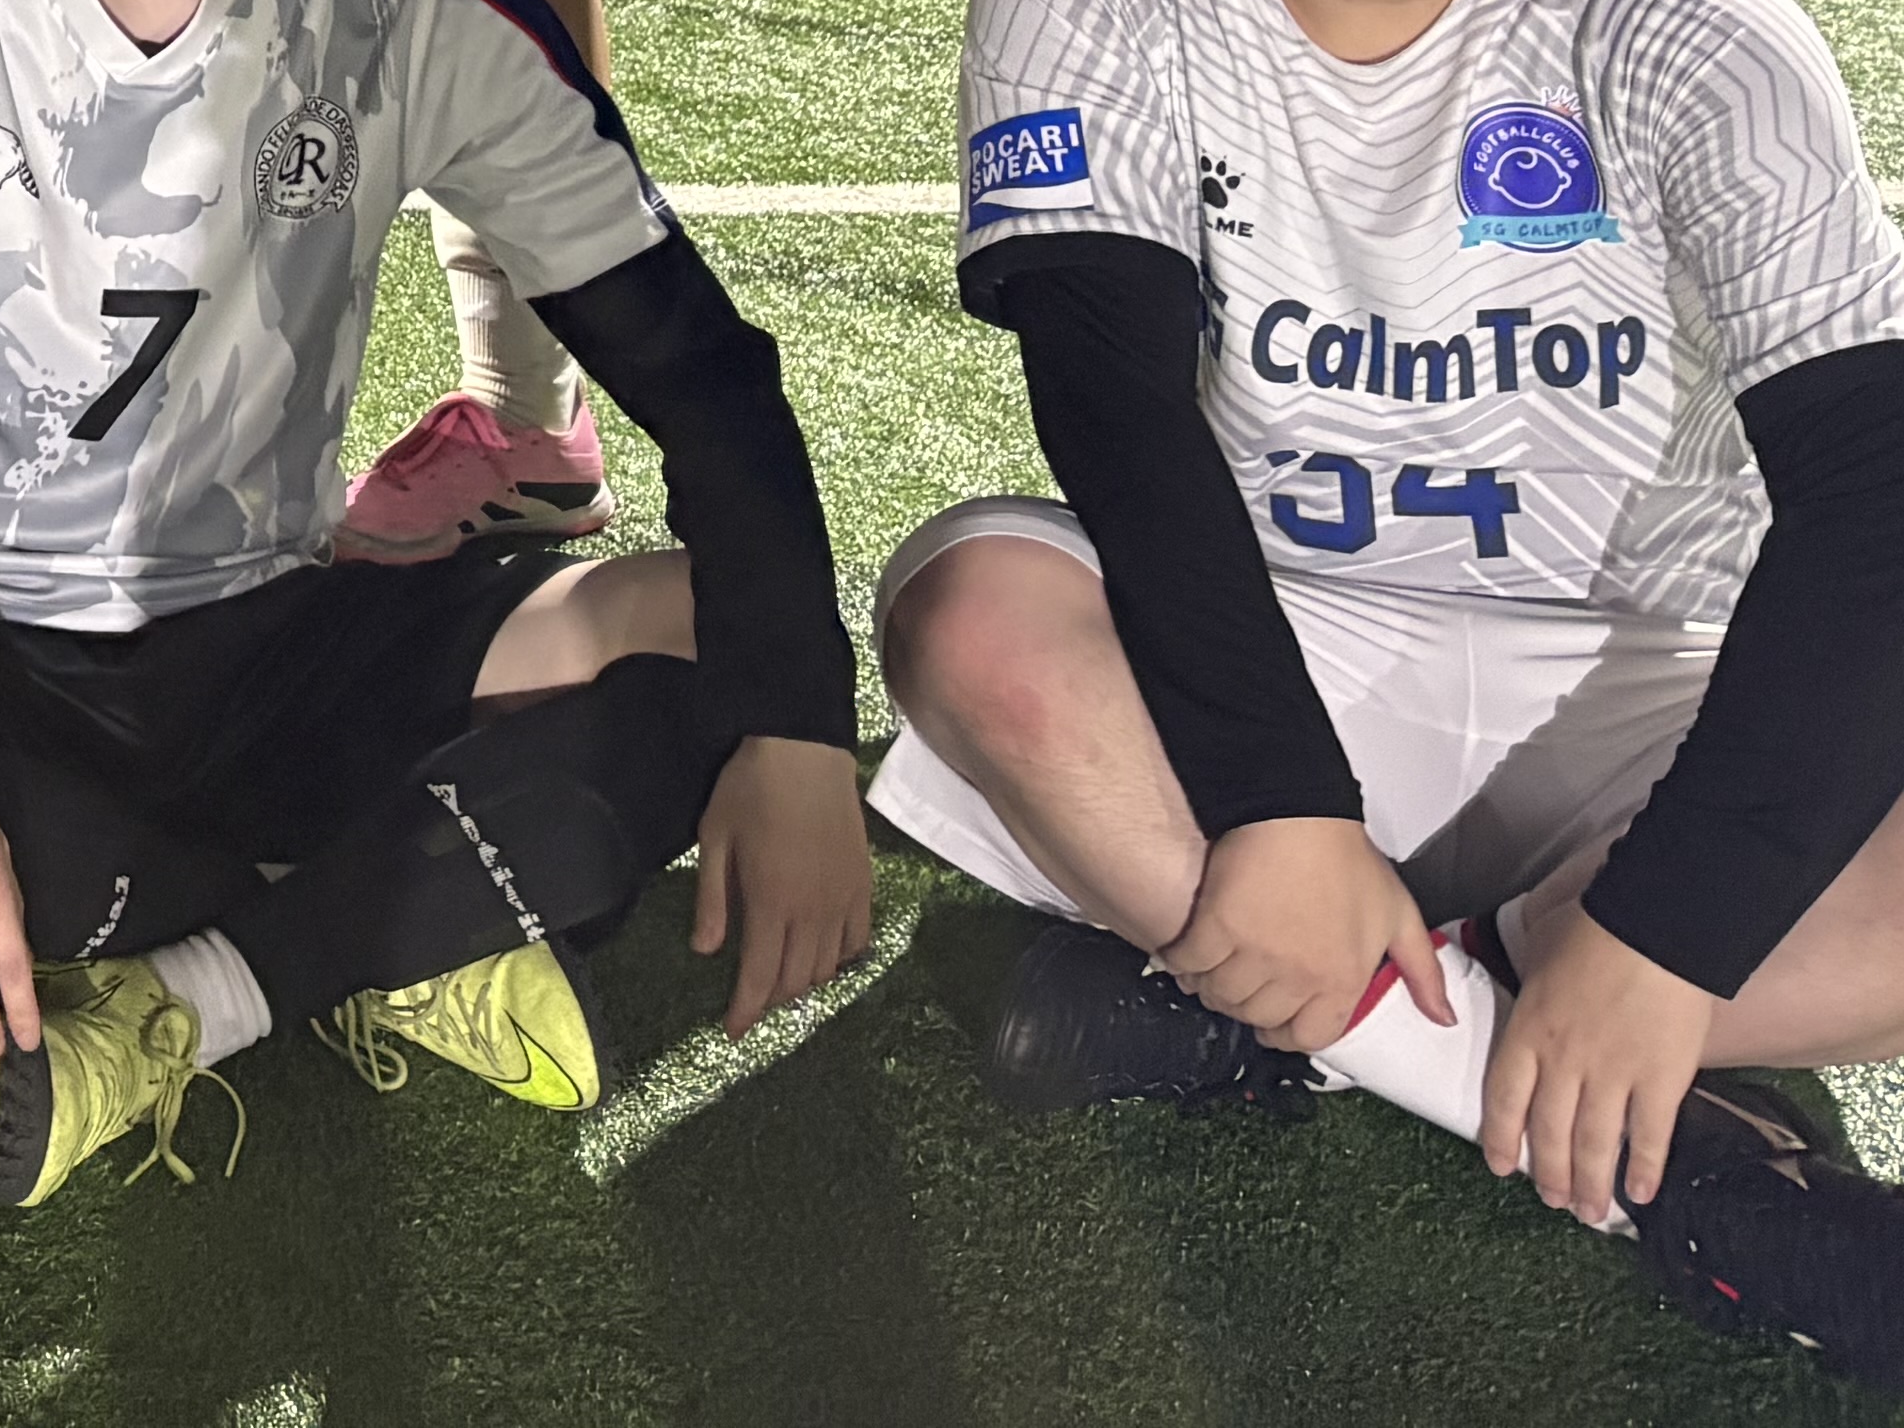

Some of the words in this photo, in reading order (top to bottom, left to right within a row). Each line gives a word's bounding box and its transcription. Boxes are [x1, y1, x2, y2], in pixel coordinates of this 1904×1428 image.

[972, 123, 1080, 172] POCARI
[972, 147, 1069, 195] SWEAT
[1473, 125, 1581, 173] FOOTBALLCLUB
[68, 288, 200, 442] 7
[1251, 298, 1646, 410] CalmTop
